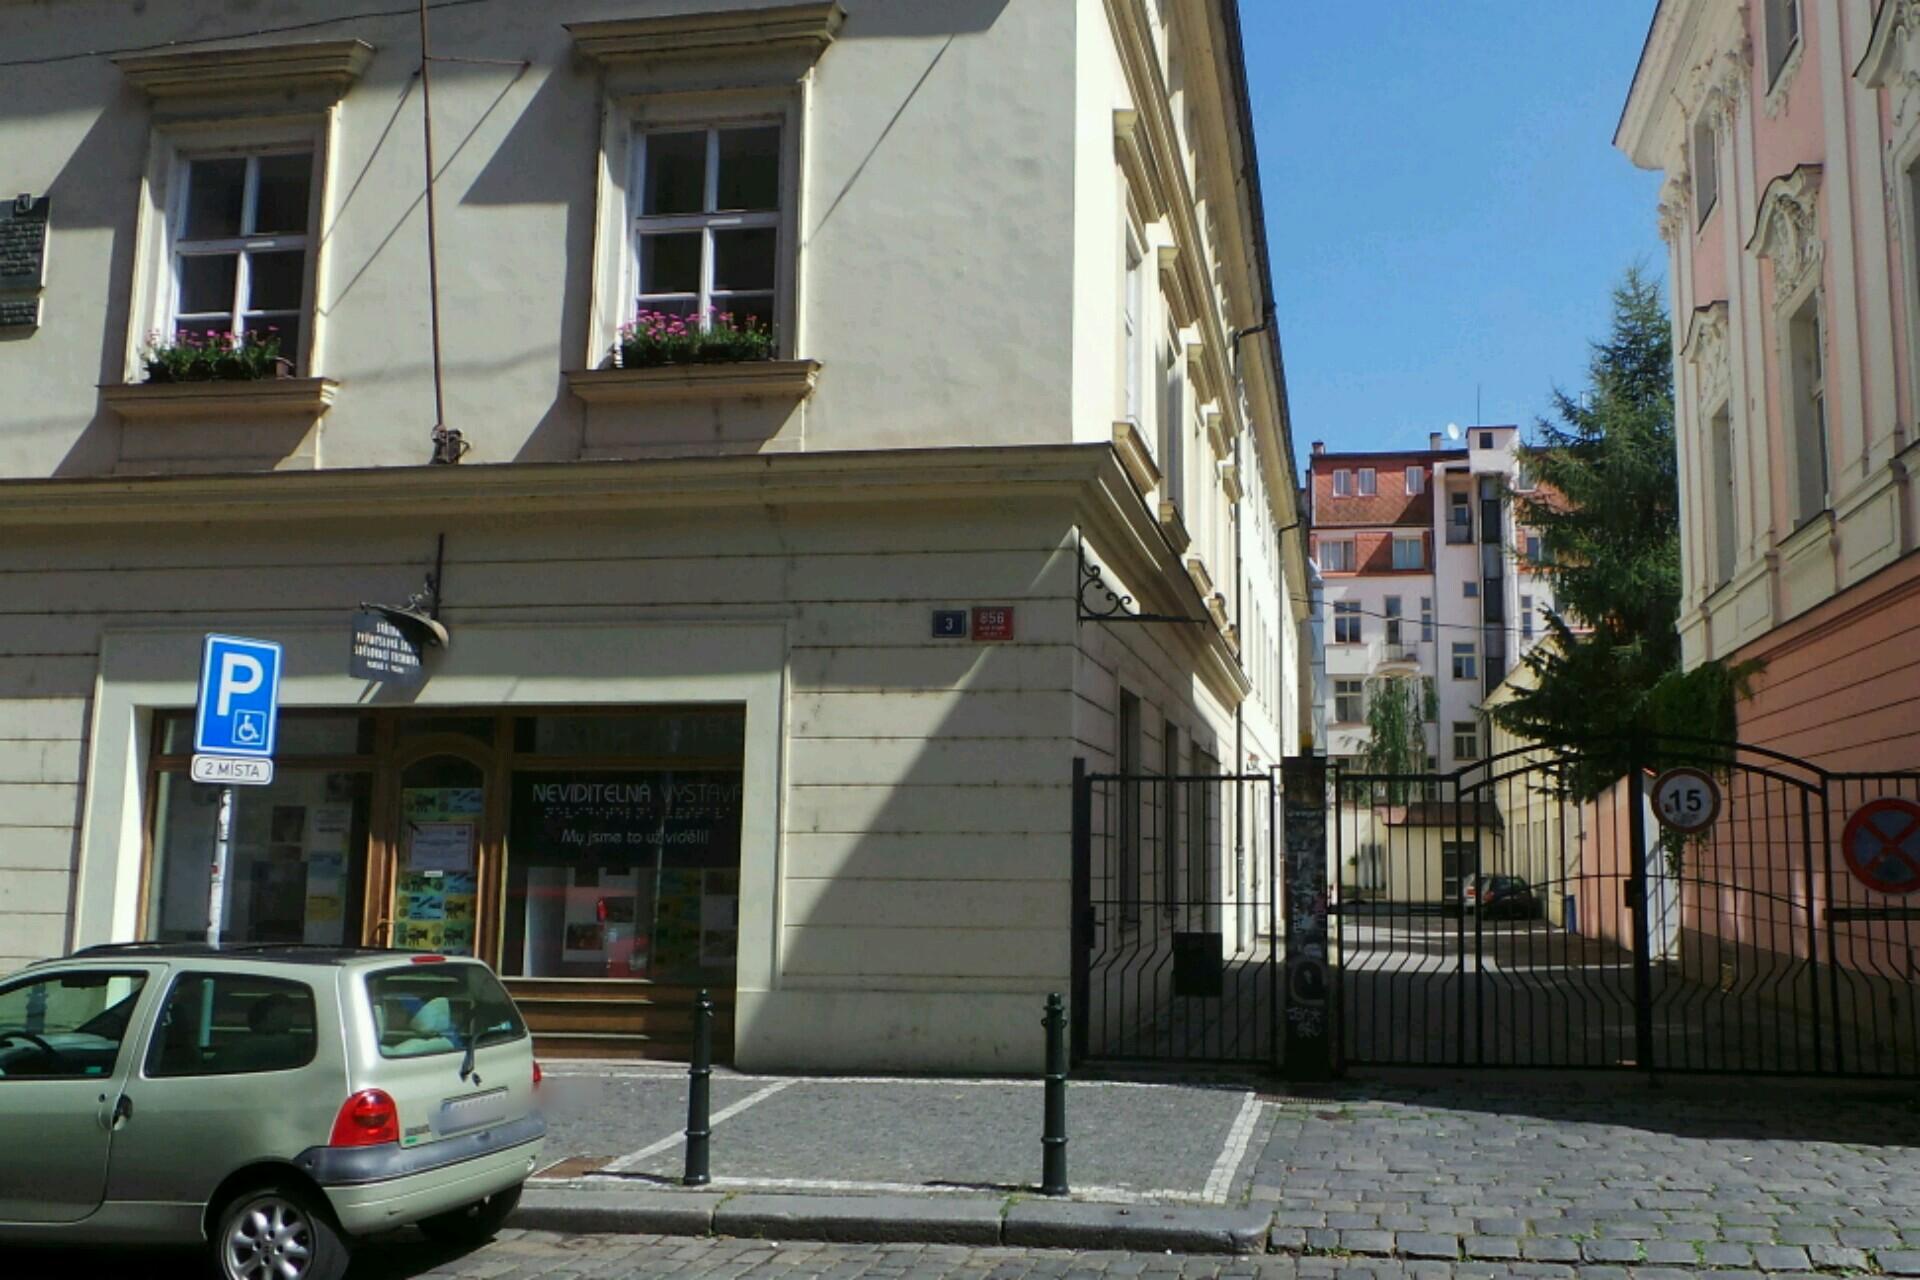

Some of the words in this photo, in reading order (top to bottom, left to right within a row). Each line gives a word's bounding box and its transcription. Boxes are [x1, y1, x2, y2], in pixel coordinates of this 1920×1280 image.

[945, 618, 953, 631] 3
[217, 652, 264, 717] P
[205, 762, 216, 776] 2
[217, 759, 260, 778] MÍSTA
[531, 781, 651, 802] NEVIDITELNÁ
[1669, 789, 1702, 812] 15
[561, 828, 583, 846] My
[585, 829, 622, 846] jsme
[626, 831, 643, 844] to
